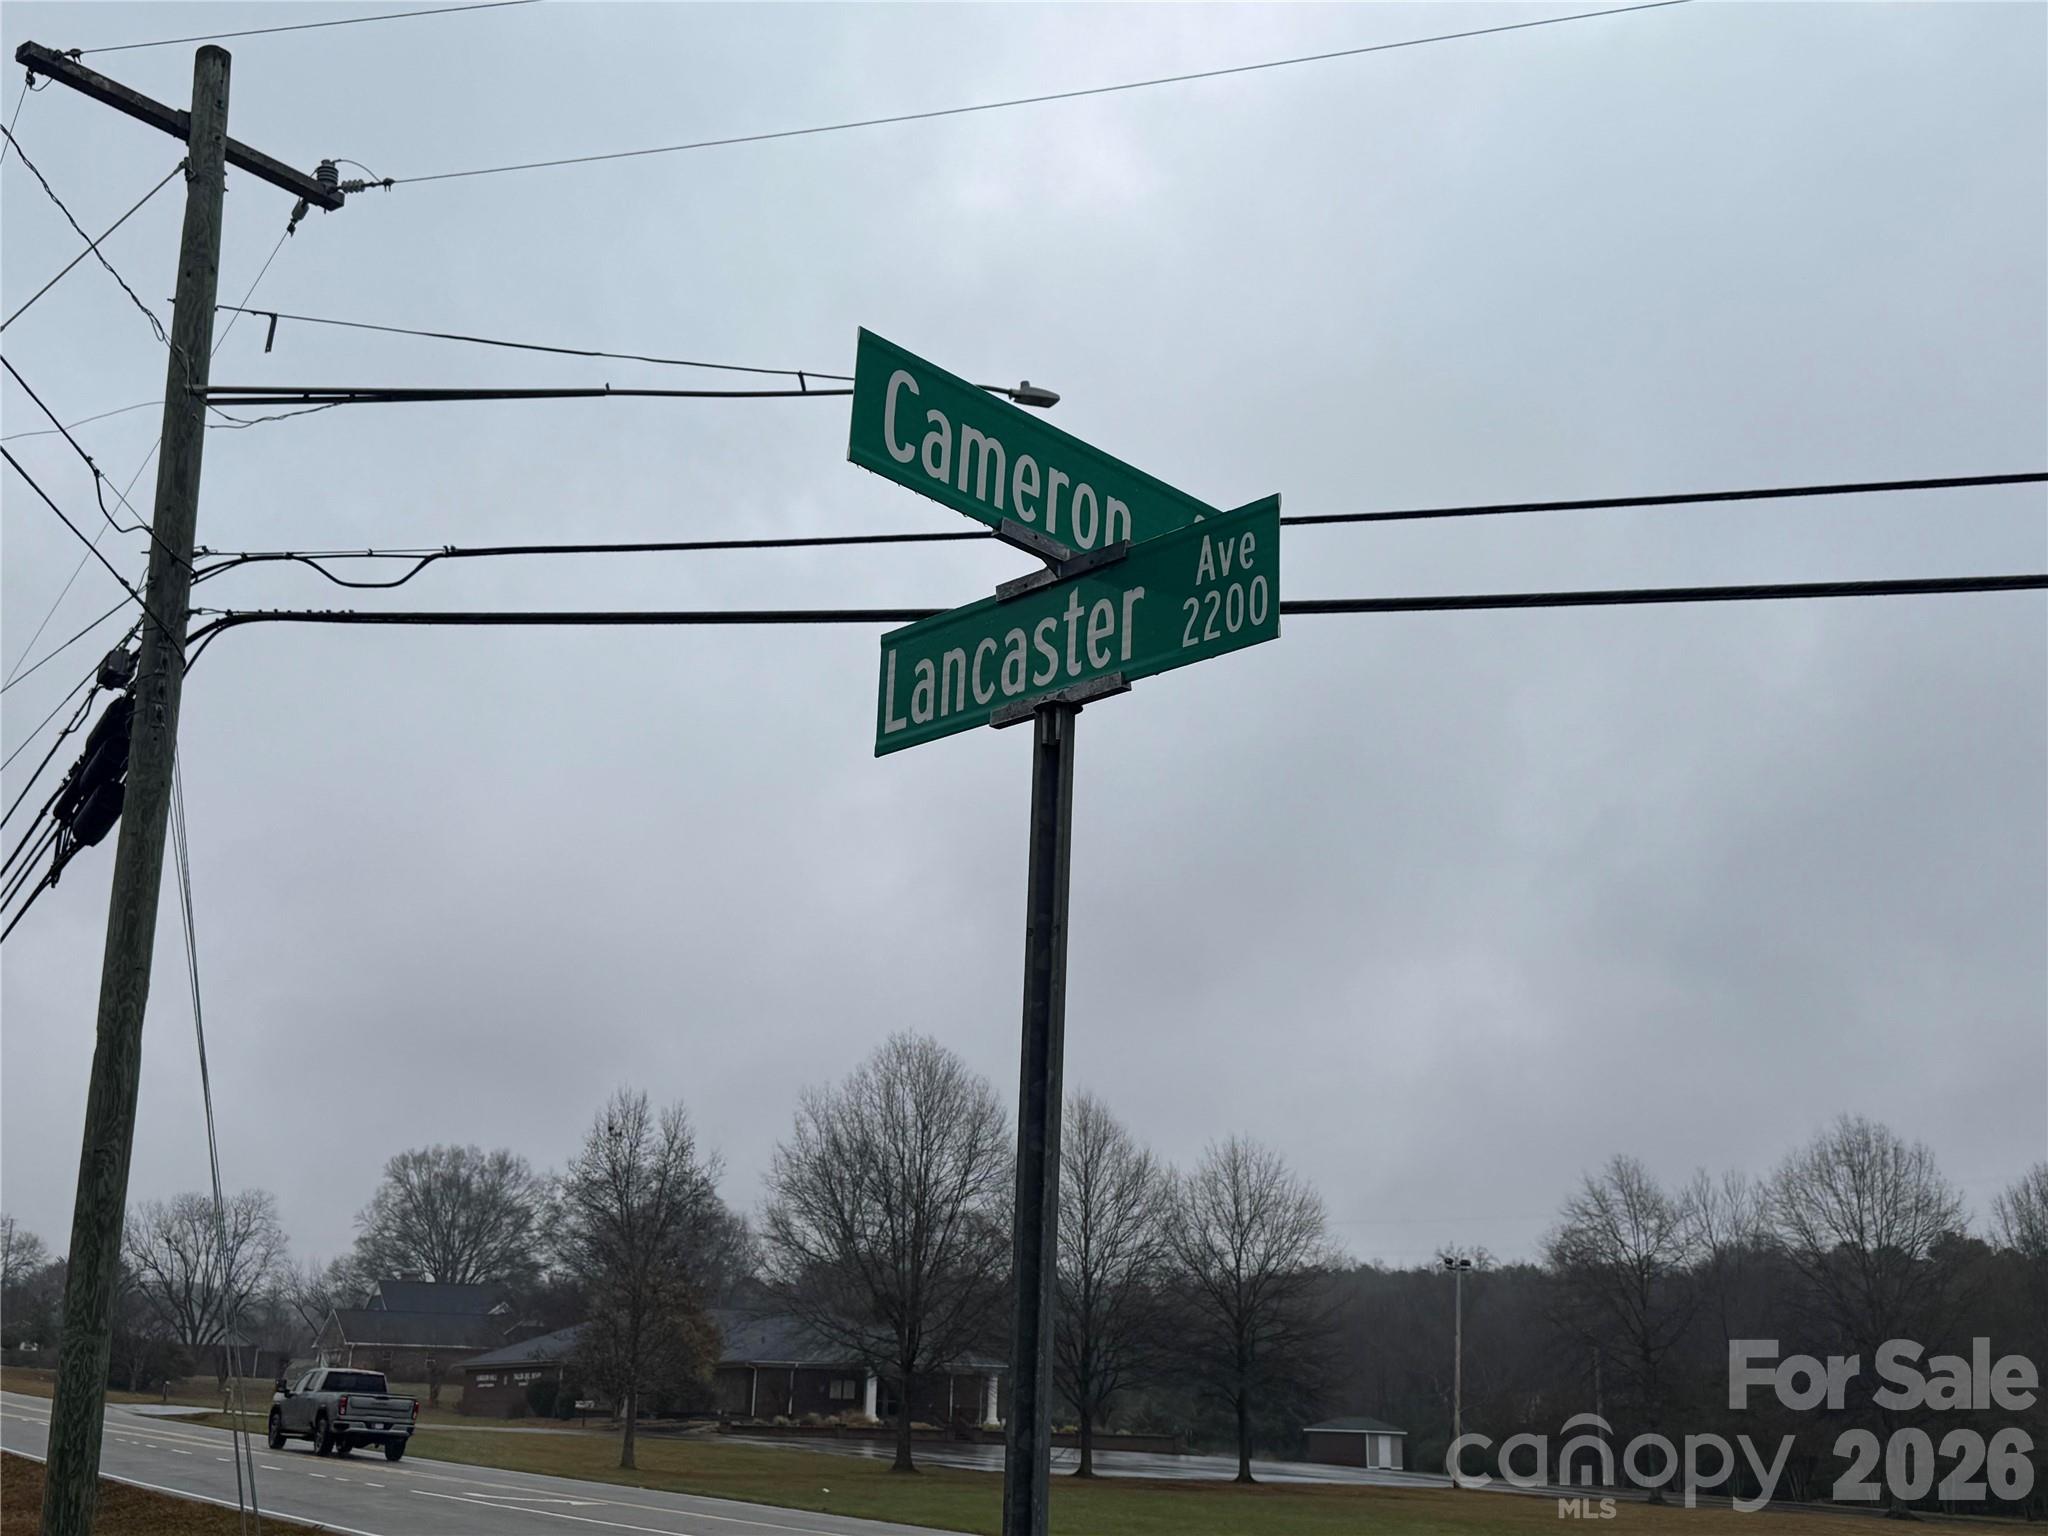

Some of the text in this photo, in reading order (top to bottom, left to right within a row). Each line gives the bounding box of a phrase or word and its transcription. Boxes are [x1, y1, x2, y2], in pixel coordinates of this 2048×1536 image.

[883, 369, 1132, 549] Cameron
[1182, 575, 1268, 648] 2200
[1195, 531, 1256, 586] Ave
[884, 586, 1145, 734] Lancaster
